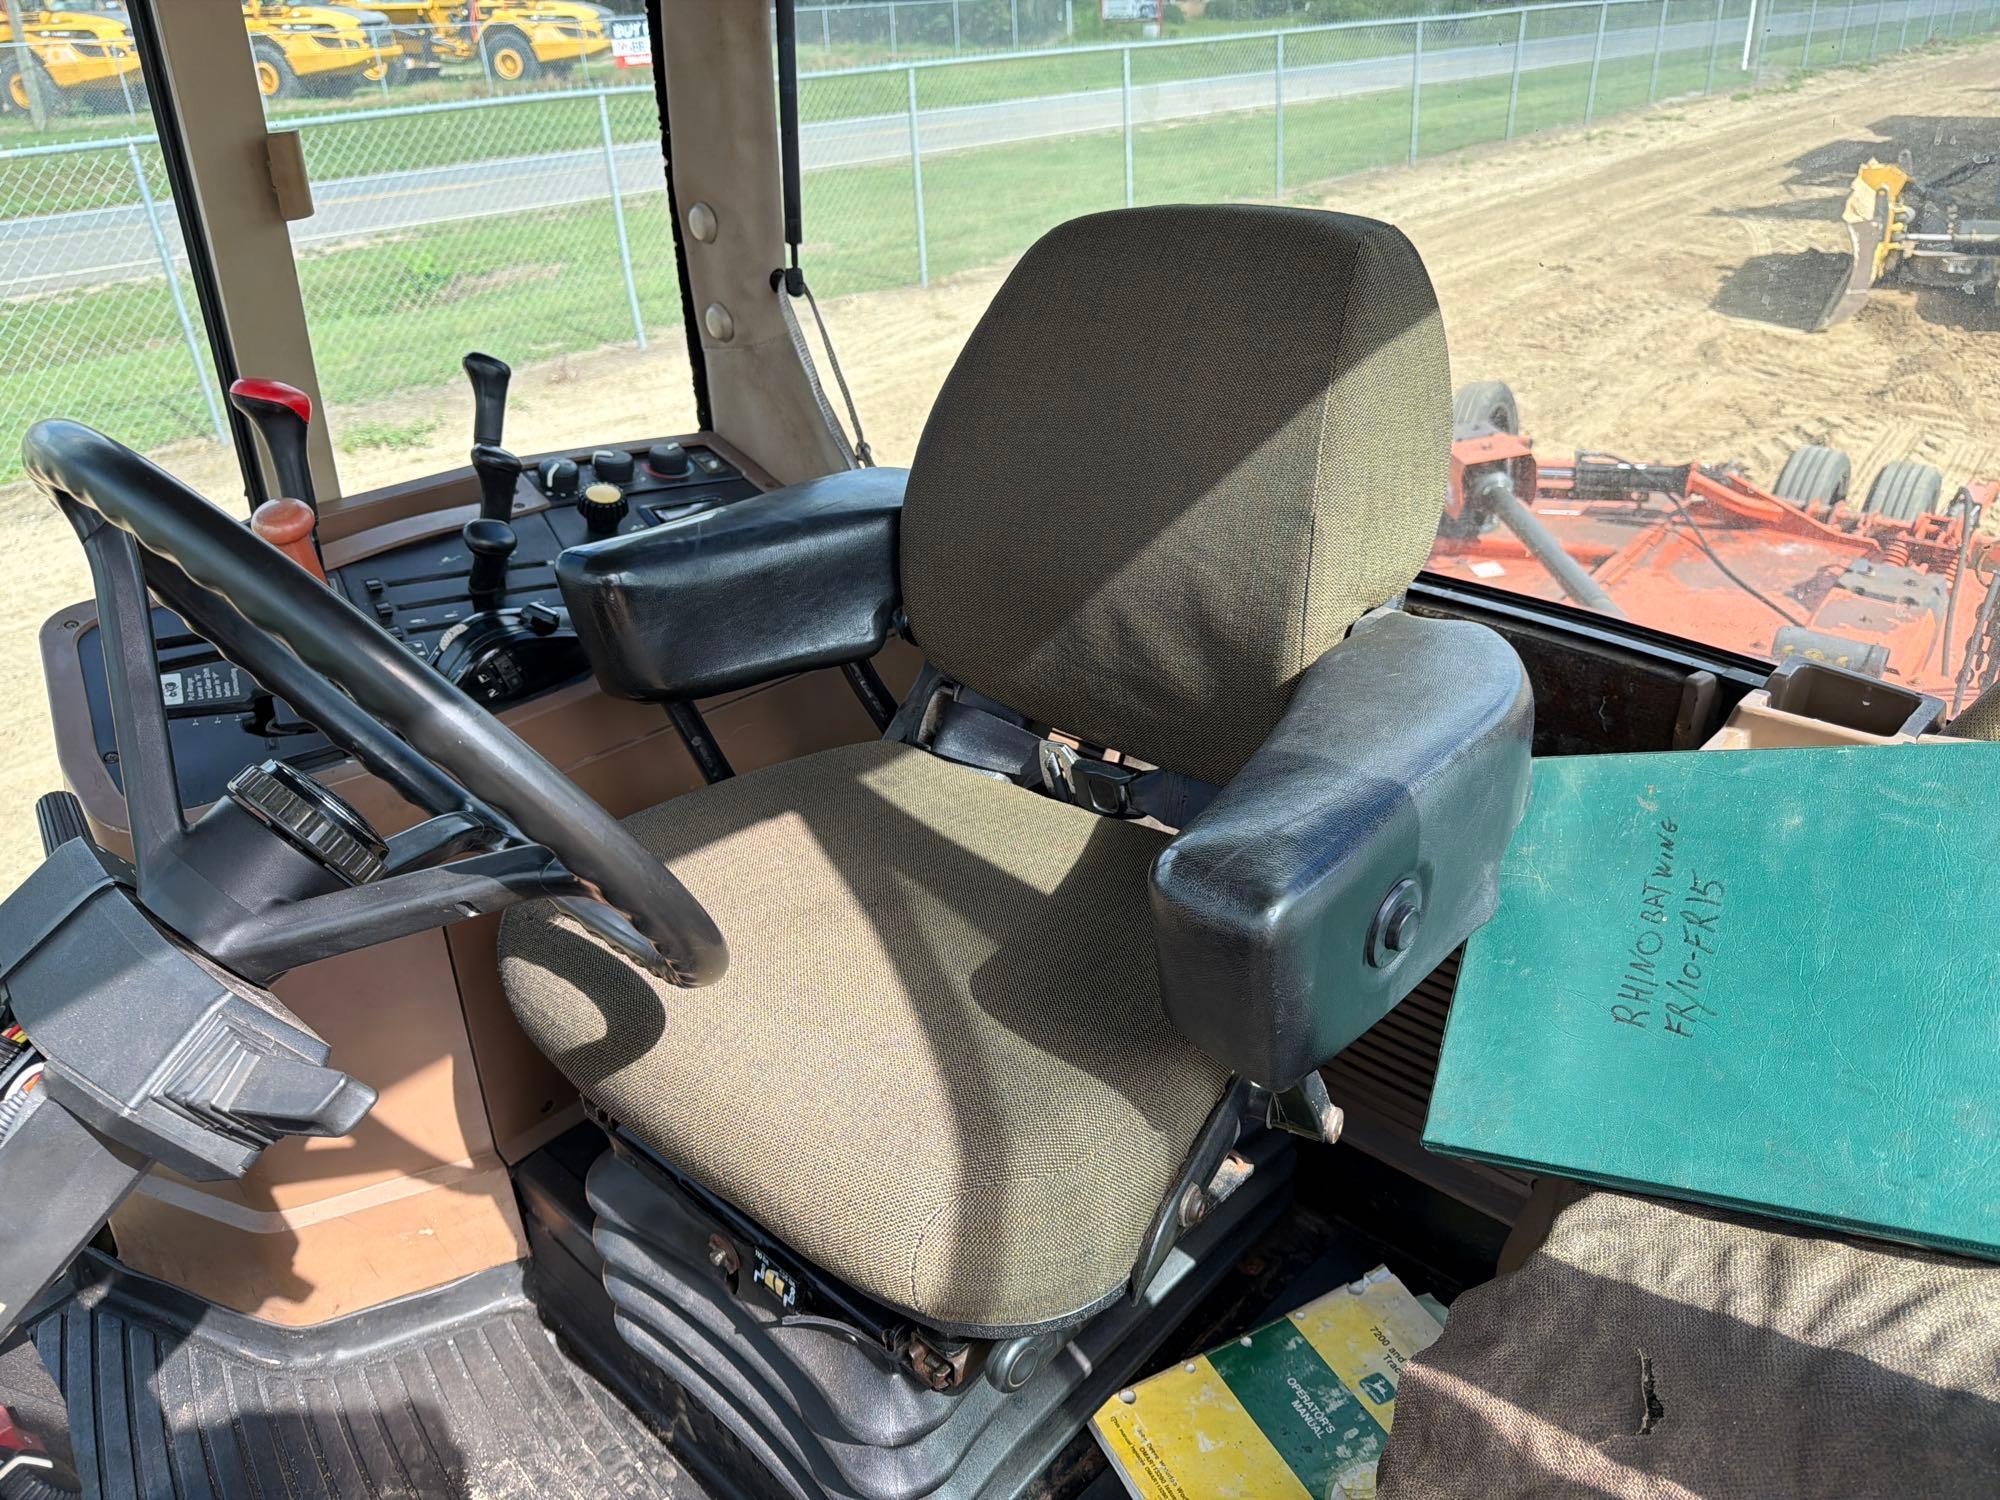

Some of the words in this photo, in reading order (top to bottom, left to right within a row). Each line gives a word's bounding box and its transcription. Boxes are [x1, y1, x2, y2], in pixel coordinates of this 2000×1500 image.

[1610, 930, 1664, 1029] RHINO
[1369, 1325, 1391, 1347] 7200
[1388, 1347, 1407, 1364] and
[1383, 1353, 1402, 1376] Trac
[1286, 1377, 1336, 1434] OPERATOR'S
[1291, 1399, 1325, 1440] MANUAL
